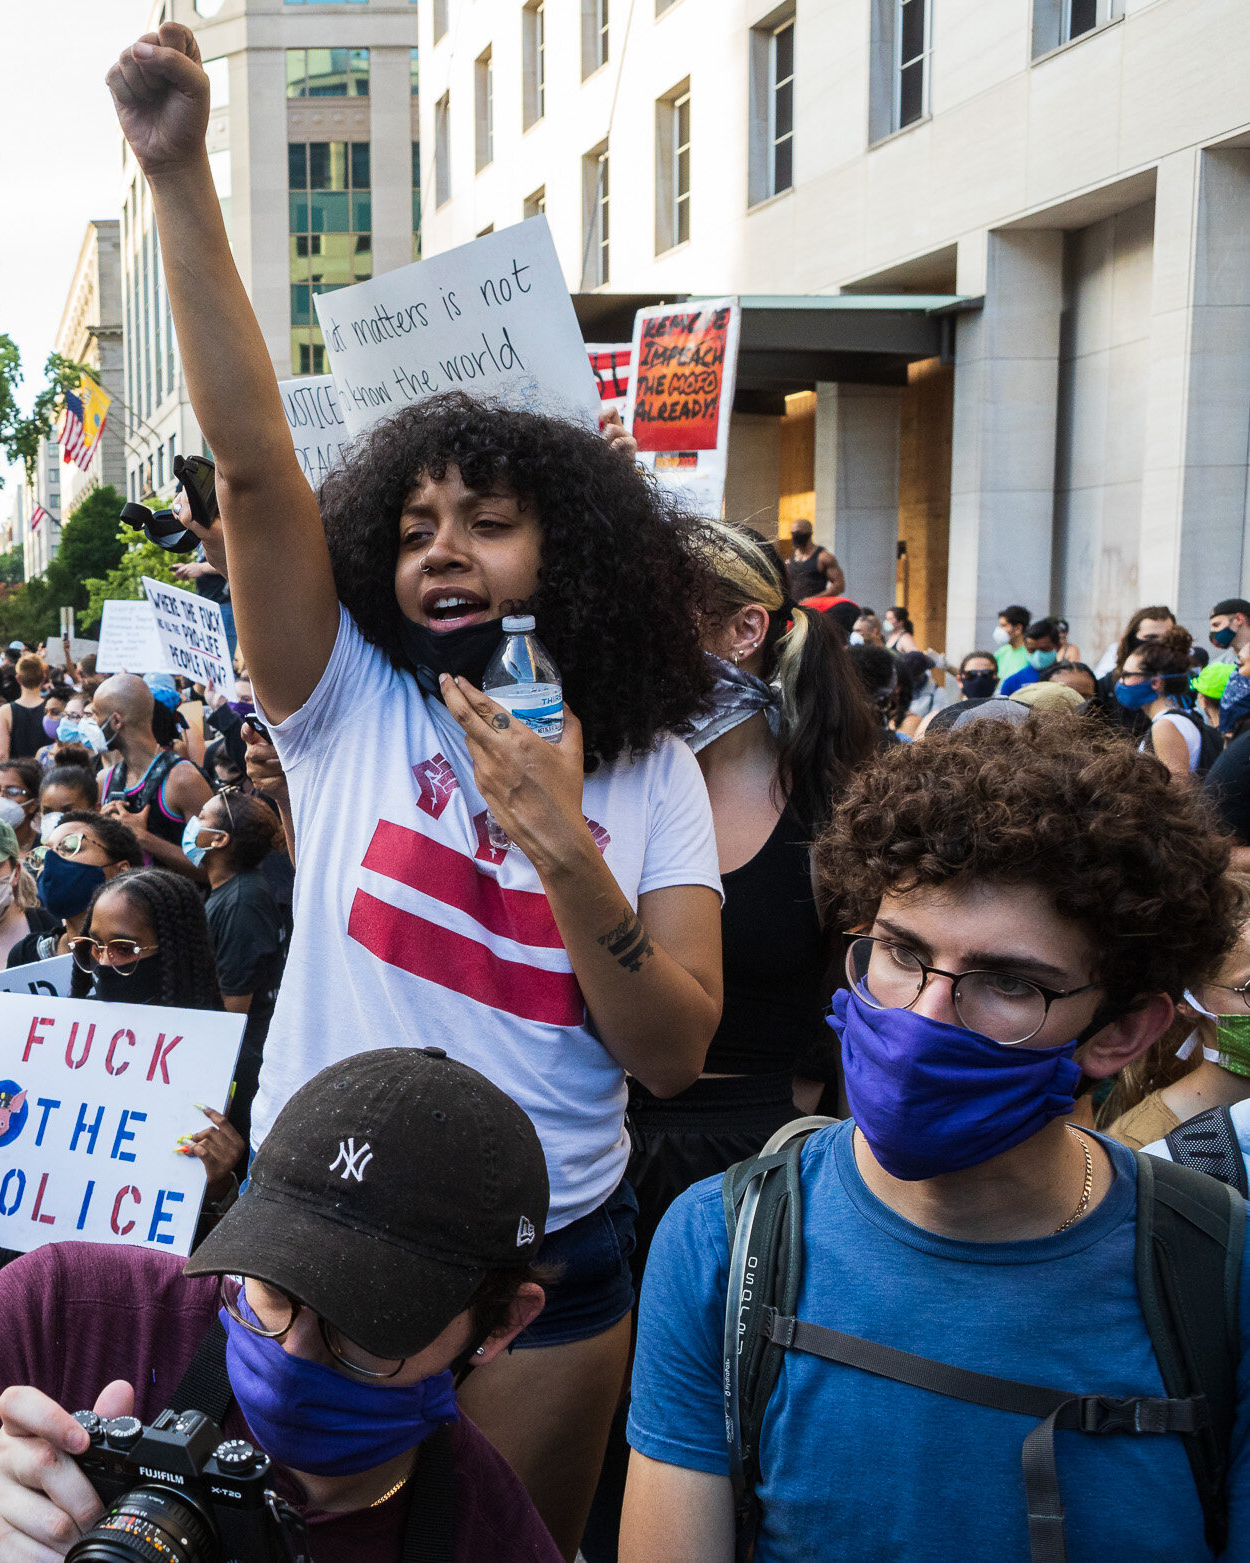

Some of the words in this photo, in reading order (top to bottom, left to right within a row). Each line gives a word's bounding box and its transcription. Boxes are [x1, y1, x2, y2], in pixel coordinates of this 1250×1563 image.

[351, 302, 428, 347] matters
[439, 288, 461, 321] is
[480, 259, 531, 307] not
[345, 377, 393, 411] know
[393, 366, 439, 401] the
[439, 327, 525, 383] world
[636, 374, 666, 398] THE
[668, 371, 718, 396] MOFO
[282, 385, 345, 429] USTICE
[634, 394, 718, 423] ALREADY!
[148, 588, 181, 618] WHERE
[180, 600, 198, 624] THE
[199, 606, 225, 638] FUCK
[181, 623, 222, 659] PRO-LIFE
[169, 643, 203, 678] PEOPLE
[202, 657, 227, 689] NOW?
[541, 693, 562, 705] THIRS
[21, 1016, 184, 1084] FUCK
[34, 1097, 148, 1163] THE
[329, 1137, 373, 1182] NY
[139, 1466, 184, 1486] FUJIFILM
[211, 1486, 242, 1500] X-T20
